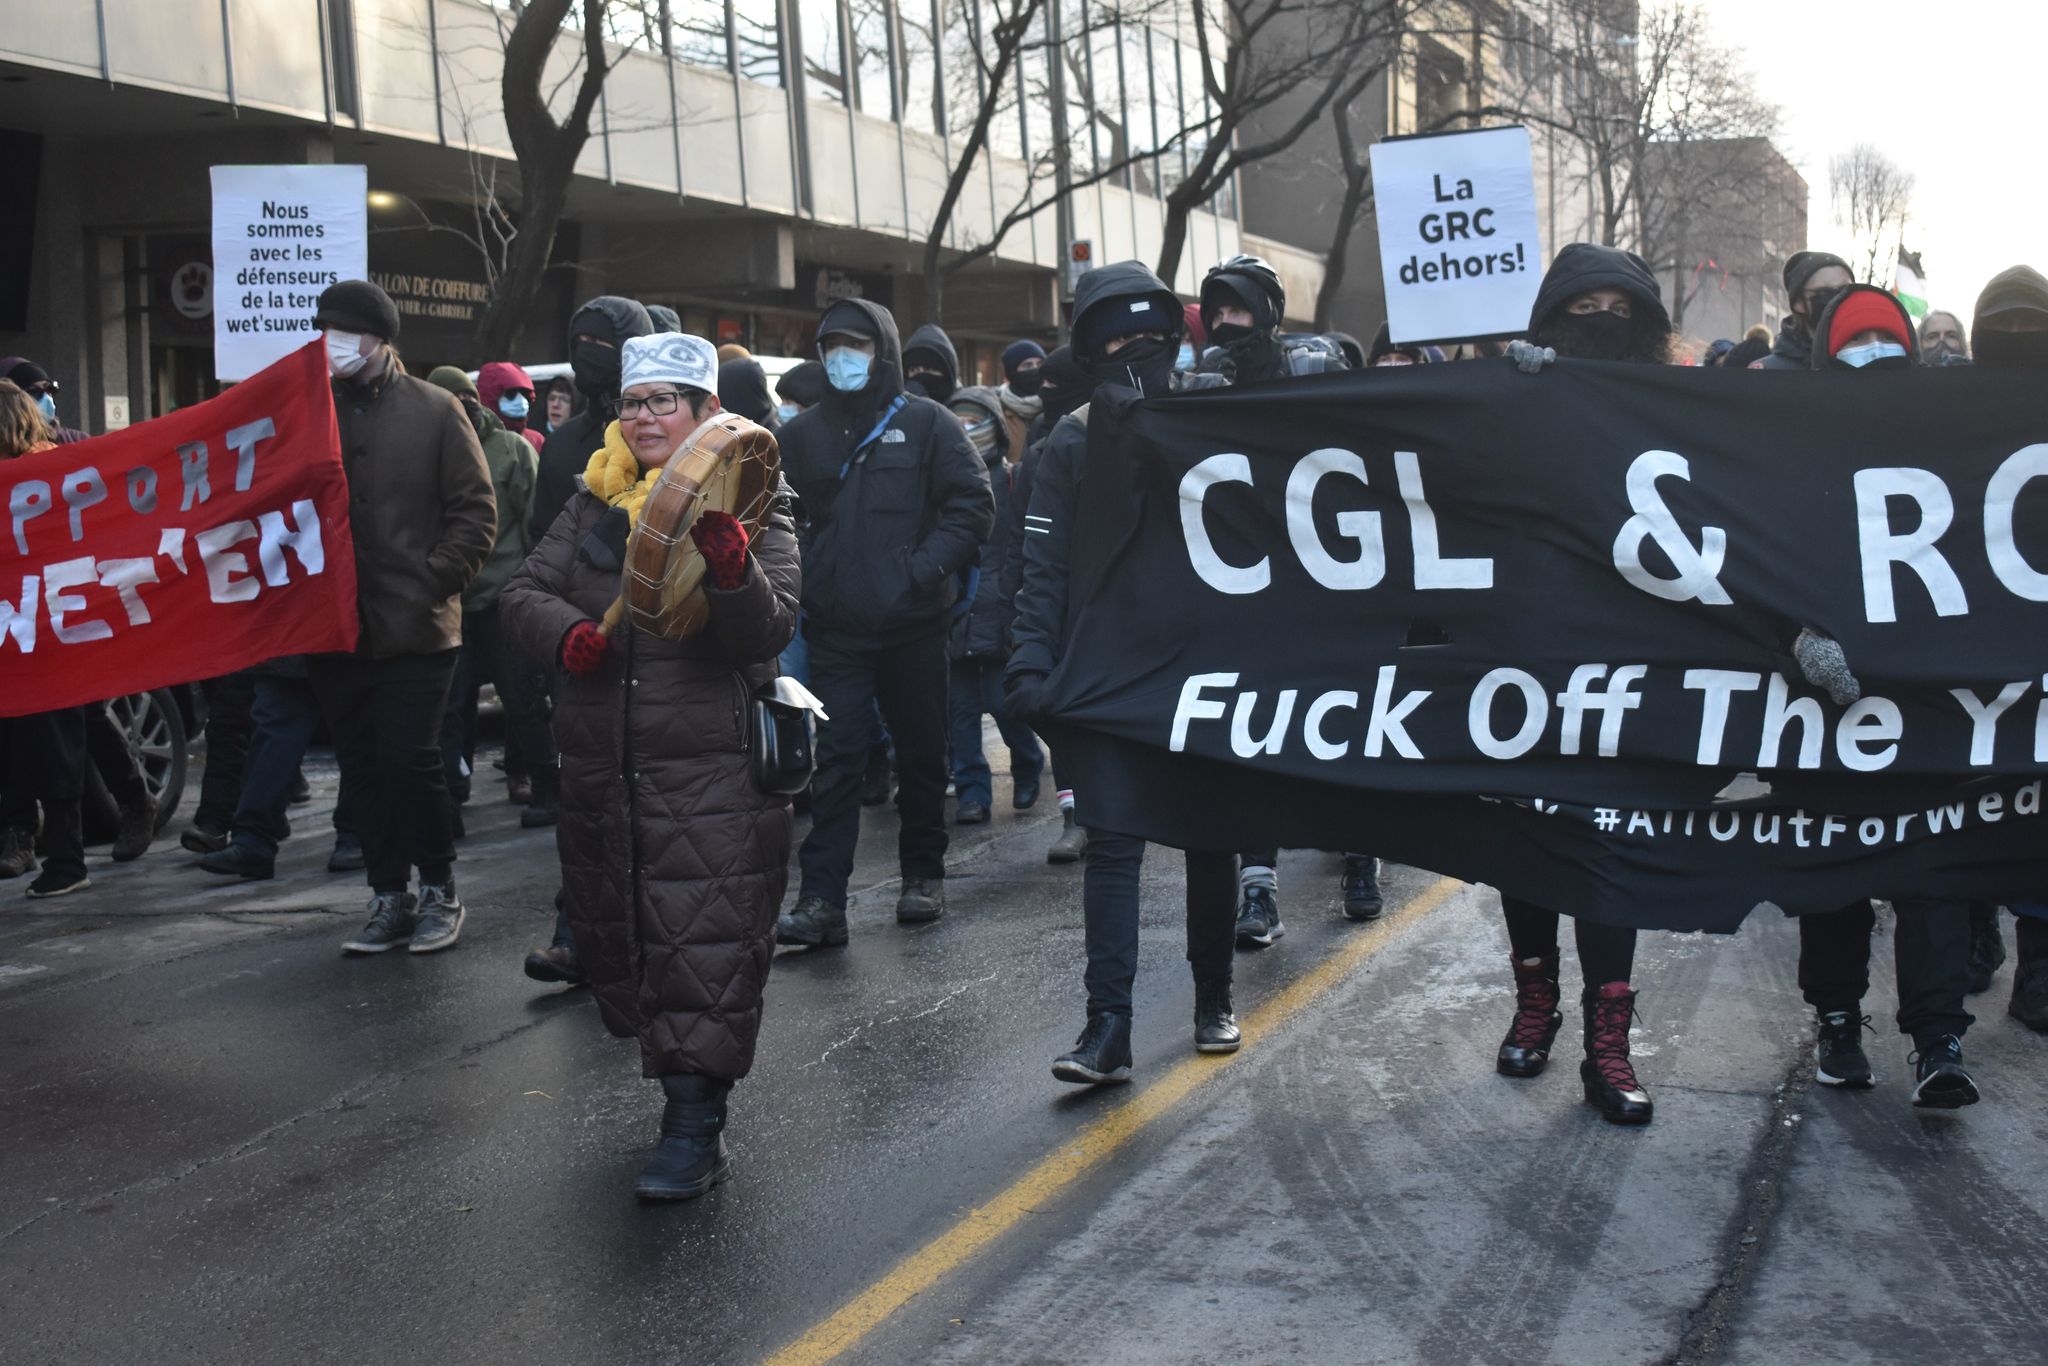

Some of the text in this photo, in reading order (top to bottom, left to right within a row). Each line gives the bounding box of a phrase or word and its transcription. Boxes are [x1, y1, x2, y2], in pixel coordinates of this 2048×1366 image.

[1433, 174, 1474, 203] La
[262, 201, 309, 219] Nous
[247, 223, 325, 238] sommes
[1419, 207, 1496, 244] GRC
[250, 244, 323, 261] avec les
[1399, 242, 1525, 285] dehors!
[236, 267, 338, 286] défenseurs
[369, 271, 489, 303] SALON DE COIFFURE
[241, 291, 263, 309] de
[268, 290, 284, 309] la
[1179, 447, 1494, 595] CGL
[1613, 449, 1734, 605] &
[1169, 664, 1433, 761] Fuck
[1468, 663, 1648, 760] Off
[1682, 668, 1904, 772] The
